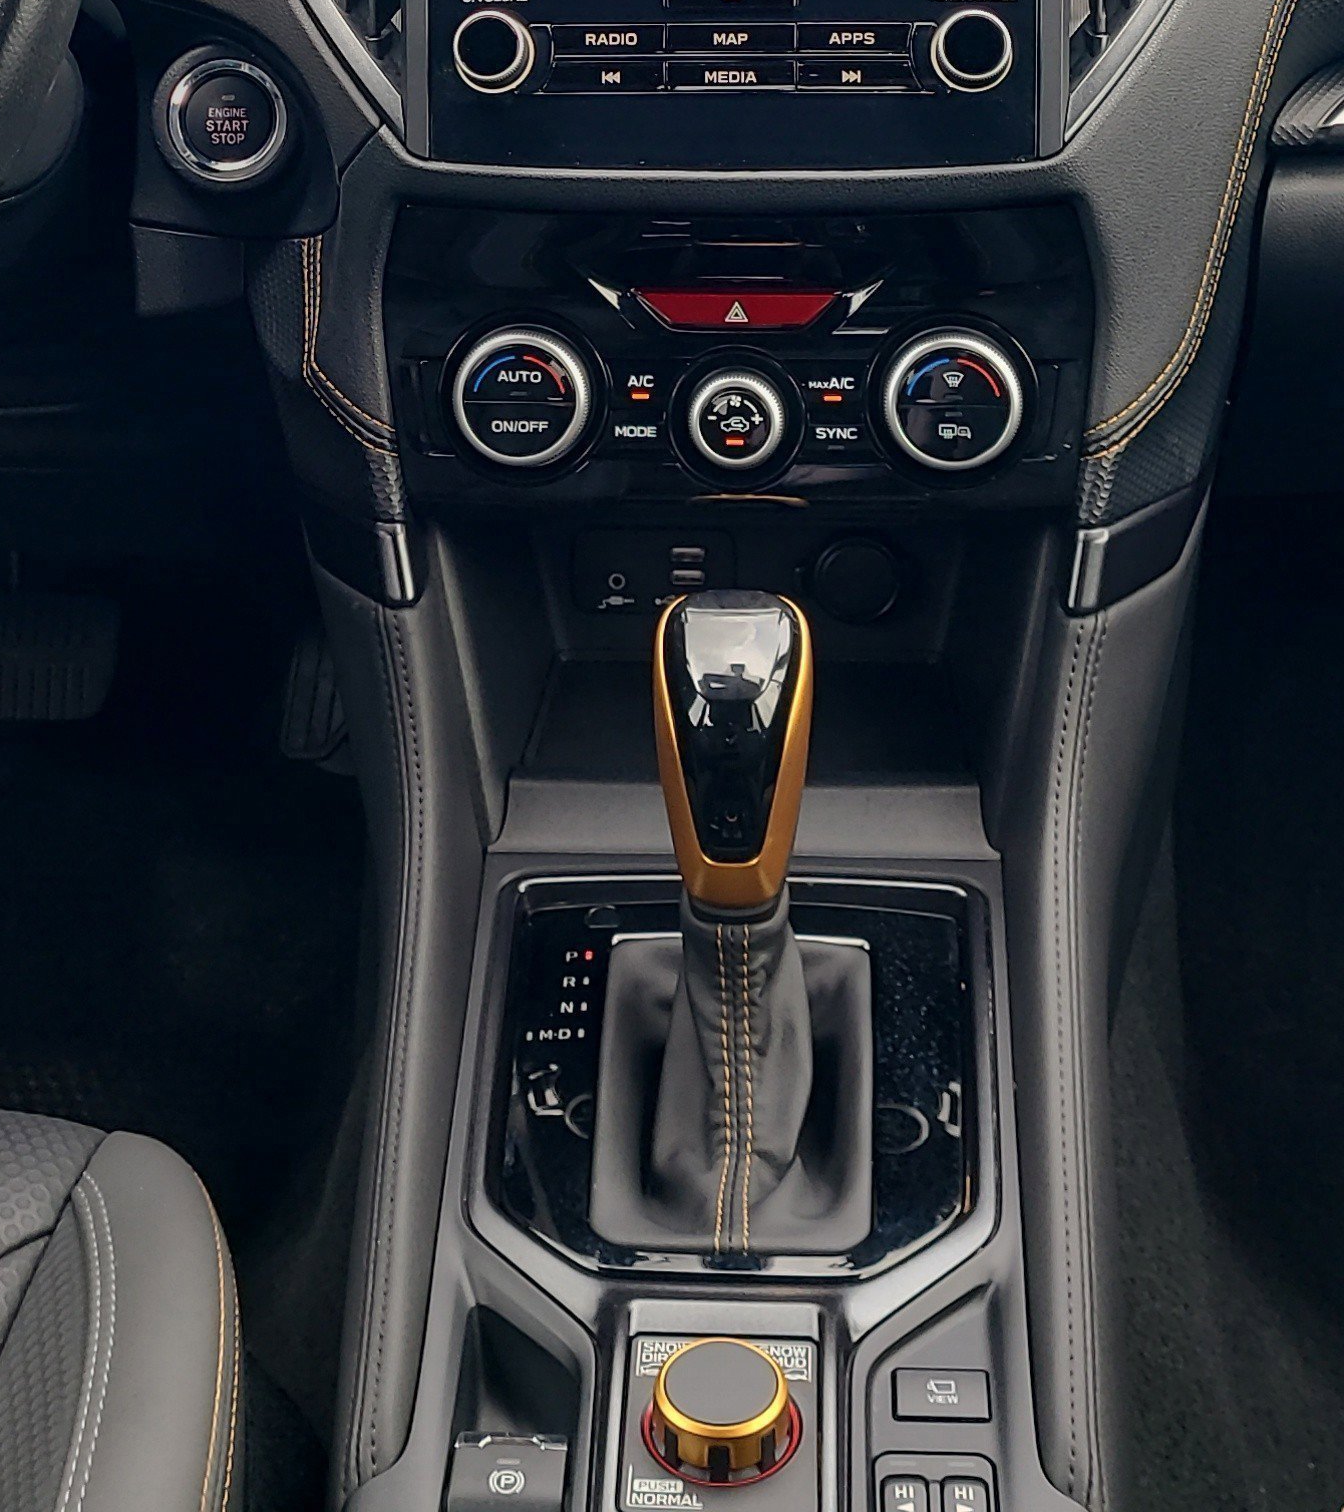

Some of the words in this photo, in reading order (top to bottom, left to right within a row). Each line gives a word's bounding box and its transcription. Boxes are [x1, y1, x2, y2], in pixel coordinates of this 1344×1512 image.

[585, 32, 638, 46] RADIO
[712, 32, 748, 46] MAP
[828, 31, 875, 46] APPS
[704, 71, 757, 84] MEDIA
[208, 107, 247, 118] ENGINE
[206, 120, 249, 132] START
[211, 133, 245, 145] STOP
[497, 371, 542, 383] AUTO
[627, 375, 654, 387] A/C
[491, 420, 549, 433] ON/OFF
[614, 426, 657, 438] MODE
[815, 427, 858, 439] SYNC
[565, 951, 578, 962] P
[563, 976, 576, 987] R
[560, 1001, 574, 1013] N
[641, 1352, 669, 1363] DIR
[927, 1393, 959, 1404] VIEW
[638, 1480, 678, 1491] PUSH
[894, 1484, 915, 1499] HI
[954, 1485, 975, 1500] HI
[631, 1493, 704, 1506] NORMAL
